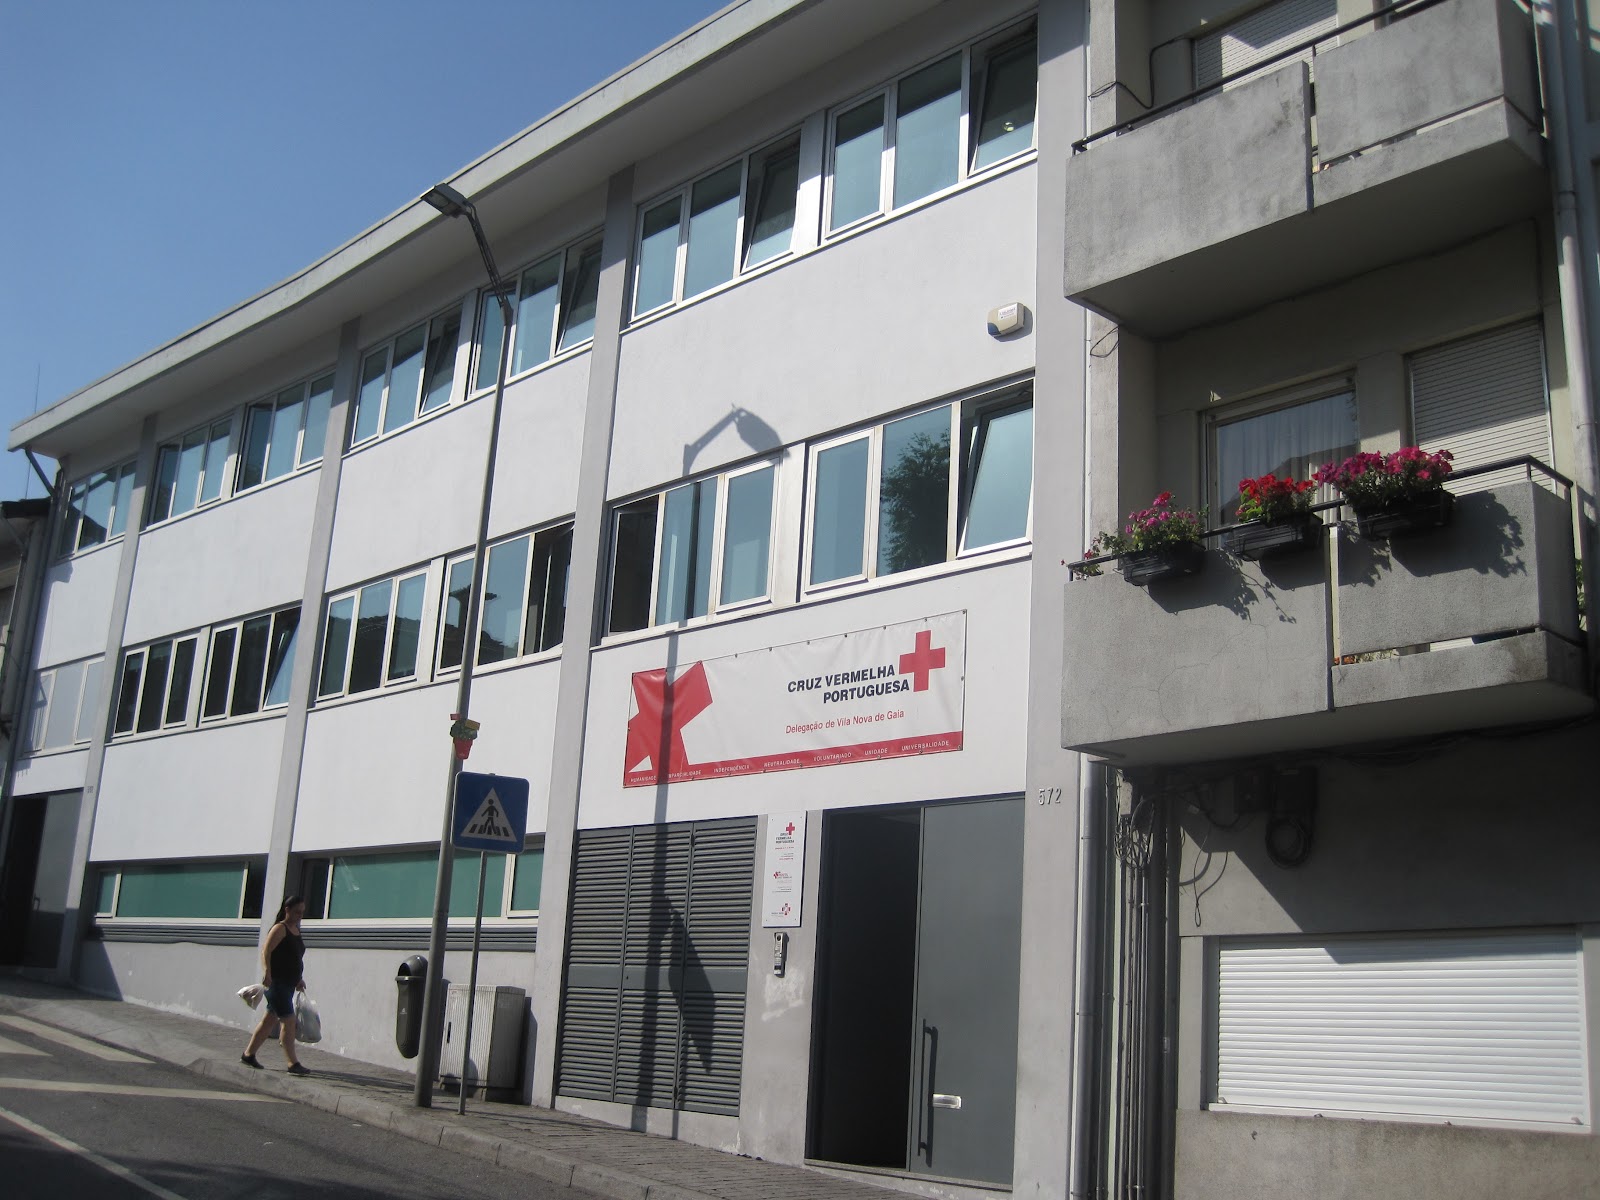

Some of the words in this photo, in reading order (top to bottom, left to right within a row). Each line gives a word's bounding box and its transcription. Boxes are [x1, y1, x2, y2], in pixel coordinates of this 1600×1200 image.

[787, 677, 822, 693] CRUZ
[825, 665, 895, 687] VERMELHA
[823, 679, 910, 704] PORTUGUESA
[786, 721, 823, 734] Delegação
[825, 720, 835, 729] de
[836, 717, 851, 727] Vila
[852, 715, 873, 725] Nova
[875, 712, 885, 722] de
[887, 709, 905, 719] Gaia
[763, 758, 800, 768] NEUTRALIDADE
[864, 748, 888, 756] UNIDADE
[901, 740, 949, 752] UNIVERSALIDADE
[1038, 786, 1062, 806] 572
